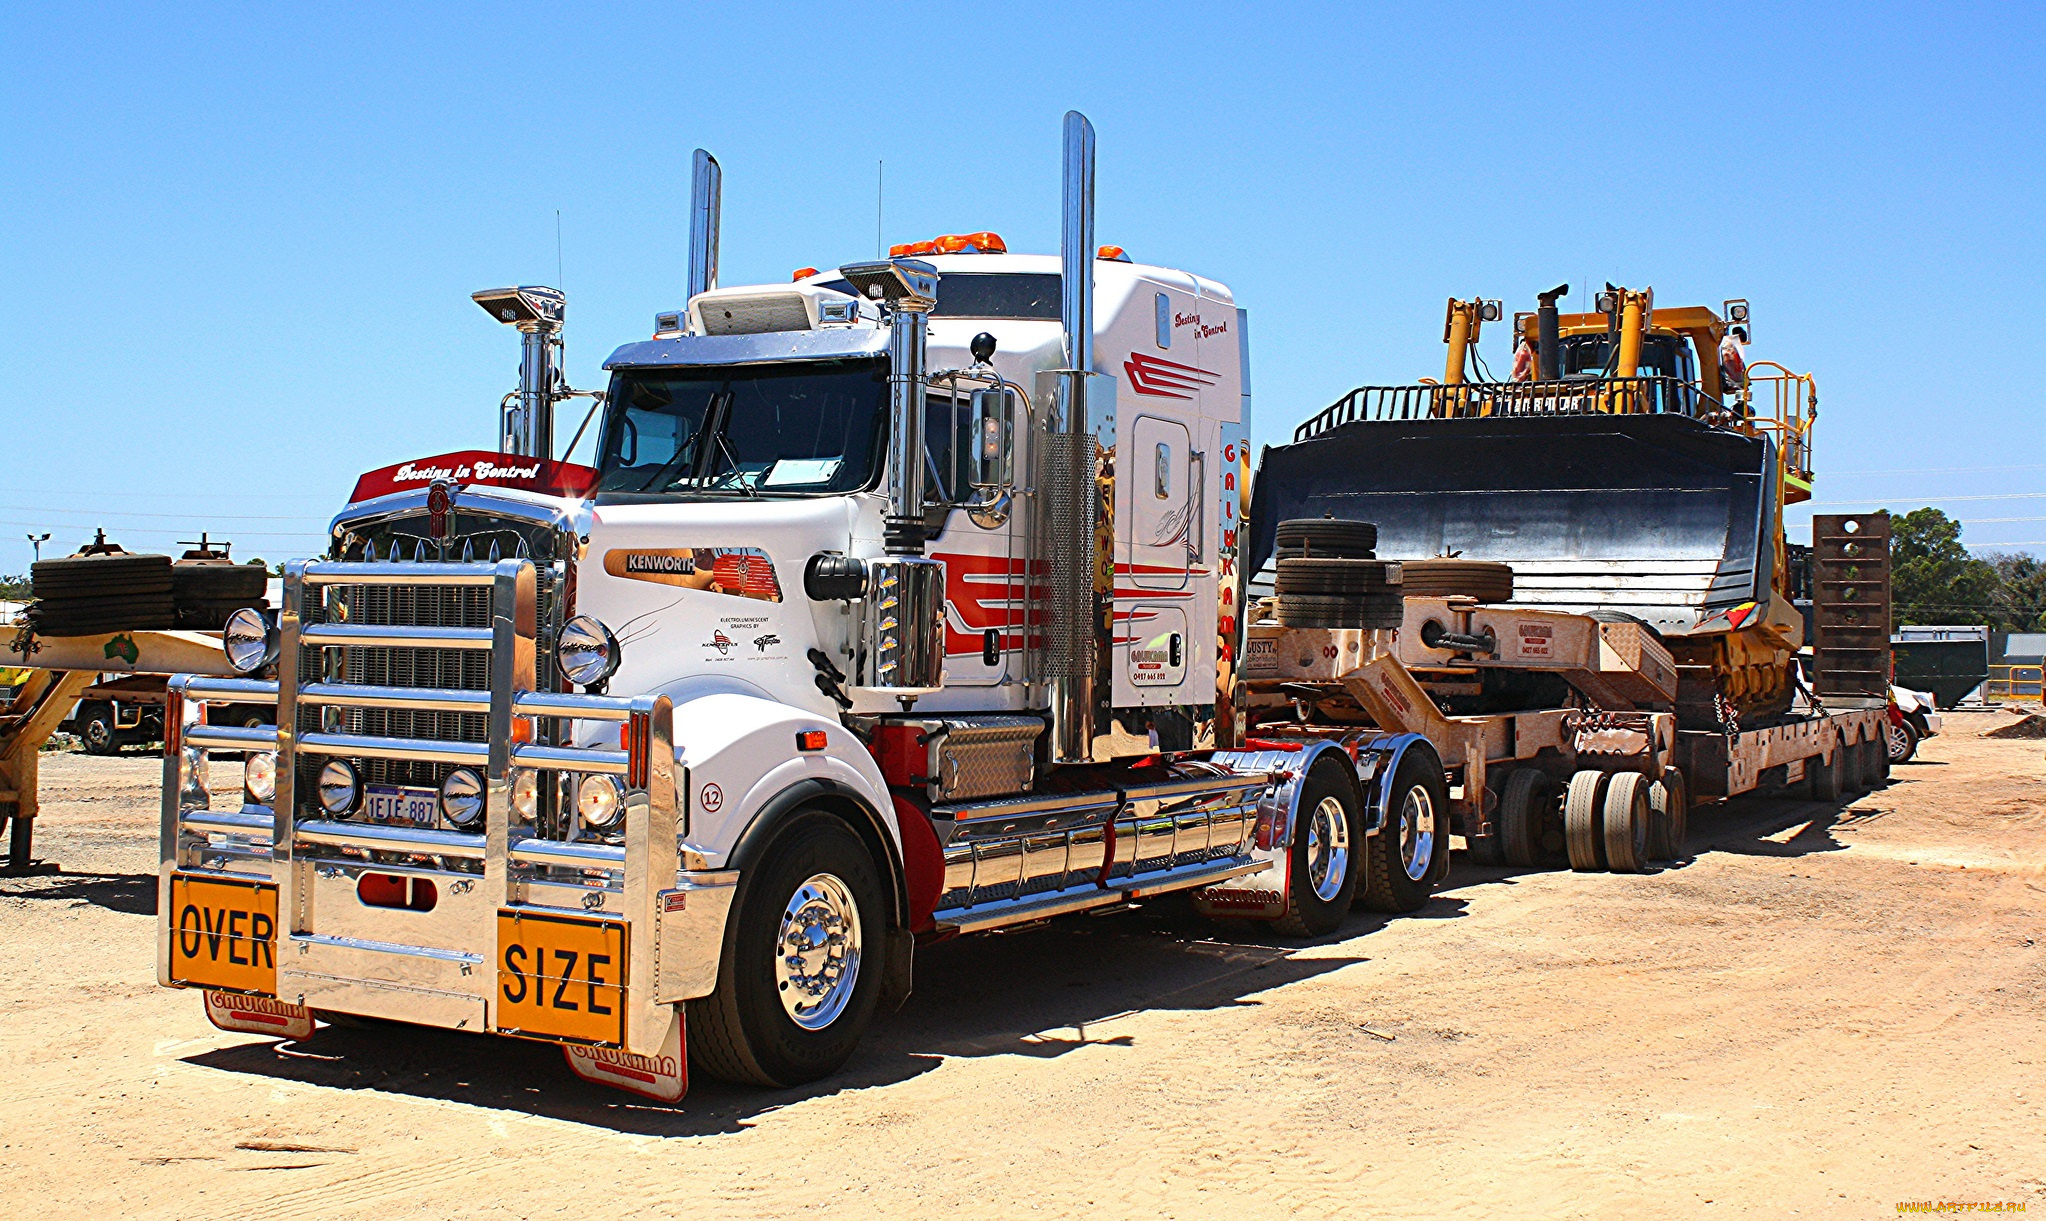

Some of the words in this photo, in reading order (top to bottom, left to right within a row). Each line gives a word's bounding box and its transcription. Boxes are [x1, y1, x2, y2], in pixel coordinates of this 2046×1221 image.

[1175, 312, 1200, 327] Destiny
[1194, 329, 1201, 339] in
[1201, 320, 1227, 338] Control
[393, 463, 452, 482] Destiny
[454, 464, 472, 479] in
[474, 461, 541, 480] Control
[1222, 444, 1235, 662] GALUKAMA
[629, 554, 696, 572] KENWORTH
[1246, 641, 1273, 653] LUSTY
[704, 790, 720, 805] 12
[180, 904, 274, 969] OVER
[503, 943, 612, 1016] SIZE
